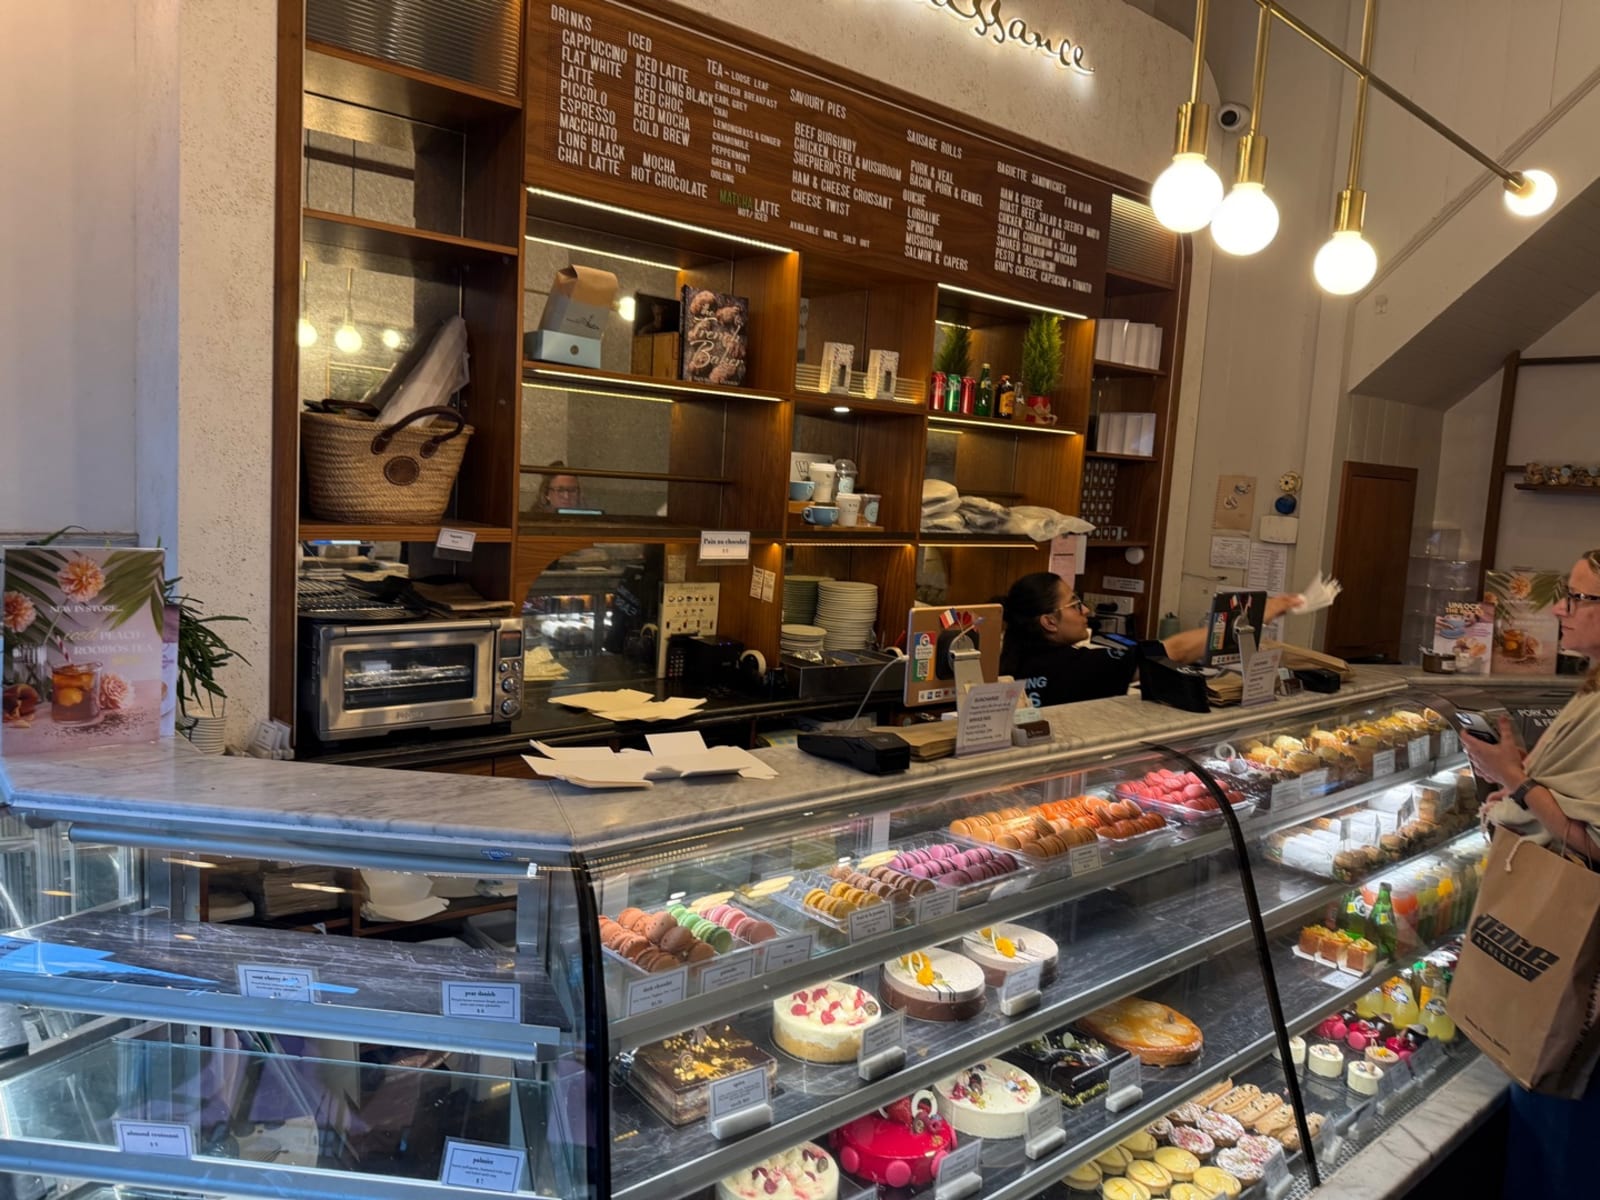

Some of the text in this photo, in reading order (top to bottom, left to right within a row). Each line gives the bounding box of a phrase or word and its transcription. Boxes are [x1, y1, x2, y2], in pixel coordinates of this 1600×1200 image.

[551, 4, 592, 32] DRINKS
[562, 29, 627, 63] CAPPUCCINO
[628, 31, 652, 53] ICED
[561, 62, 594, 86] LATTE
[562, 45, 622, 78] FLAT WHITE
[636, 53, 689, 84] ICED LATTE
[706, 58, 723, 78] TEA
[731, 70, 751, 86] LOOSE
[753, 79, 769, 91] LEAF
[560, 79, 607, 106] PICCOLO
[635, 69, 714, 108] ICED LONG BLACK
[635, 85, 684, 113] ICED CHOC
[714, 93, 748, 112] EARL GREY
[715, 80, 778, 109] ENGLISH BREAKFAST
[560, 96, 616, 125] ESPRESSO
[634, 101, 690, 131] ICED MOCHA
[790, 88, 847, 119] SAVOURY PIES
[560, 112, 617, 142] MACCHIATO
[633, 118, 690, 147] COLD BREW
[712, 131, 750, 151] CHAMOMILE
[713, 118, 754, 139] LEMONGRASS
[760, 133, 782, 148] GINGER
[794, 121, 857, 153] BEEF BURGUNDY
[559, 128, 625, 161] LONG BLACK
[711, 143, 750, 163] PEPPERMINT
[906, 129, 962, 159] SAUSAGE ROLLS
[558, 145, 620, 176] CHAI LATTE
[642, 151, 676, 175] MOCHA
[711, 156, 747, 175] GREEN TEA
[793, 150, 857, 182] SHEPHERD'S PIE
[832, 149, 853, 166] LEEK
[855, 156, 860, 169] &
[861, 158, 902, 182] MUSHROOM
[910, 160, 954, 185] PORK & VEAL
[631, 164, 708, 199] HOT CHOCOLATE
[710, 169, 735, 184] OOLONG
[792, 169, 893, 210] HAM & CHEESE CROISSANT
[997, 160, 1067, 195] BAGUETTE SANDWICHES
[720, 189, 780, 218] MATCHA LATTE
[791, 188, 851, 217] CHEESE TWIST
[902, 188, 927, 207] QUICHE
[935, 180, 952, 197] PORK
[953, 187, 959, 199] &
[960, 189, 984, 207] FENNEL
[1000, 187, 1014, 201] HAM
[1021, 194, 1044, 211] CHEESE
[907, 205, 941, 226] LORRAINE
[999, 199, 1019, 215] ROAST
[1039, 211, 1057, 227] SALAD
[1024, 220, 1044, 234] SALAD
[789, 220, 819, 236] AVAILABLE
[905, 231, 943, 252] MUSHROOM
[906, 218, 934, 237] SPINACH
[995, 247, 1015, 262] PESTO
[996, 235, 1020, 252] SMOKED
[1059, 242, 1077, 256] SALAD
[904, 244, 932, 263] SALMON
[943, 254, 969, 272] CAPERS
[690, 338, 743, 369] Baker
[50, 605, 72, 613] NEW
[74, 605, 85, 613] IN
